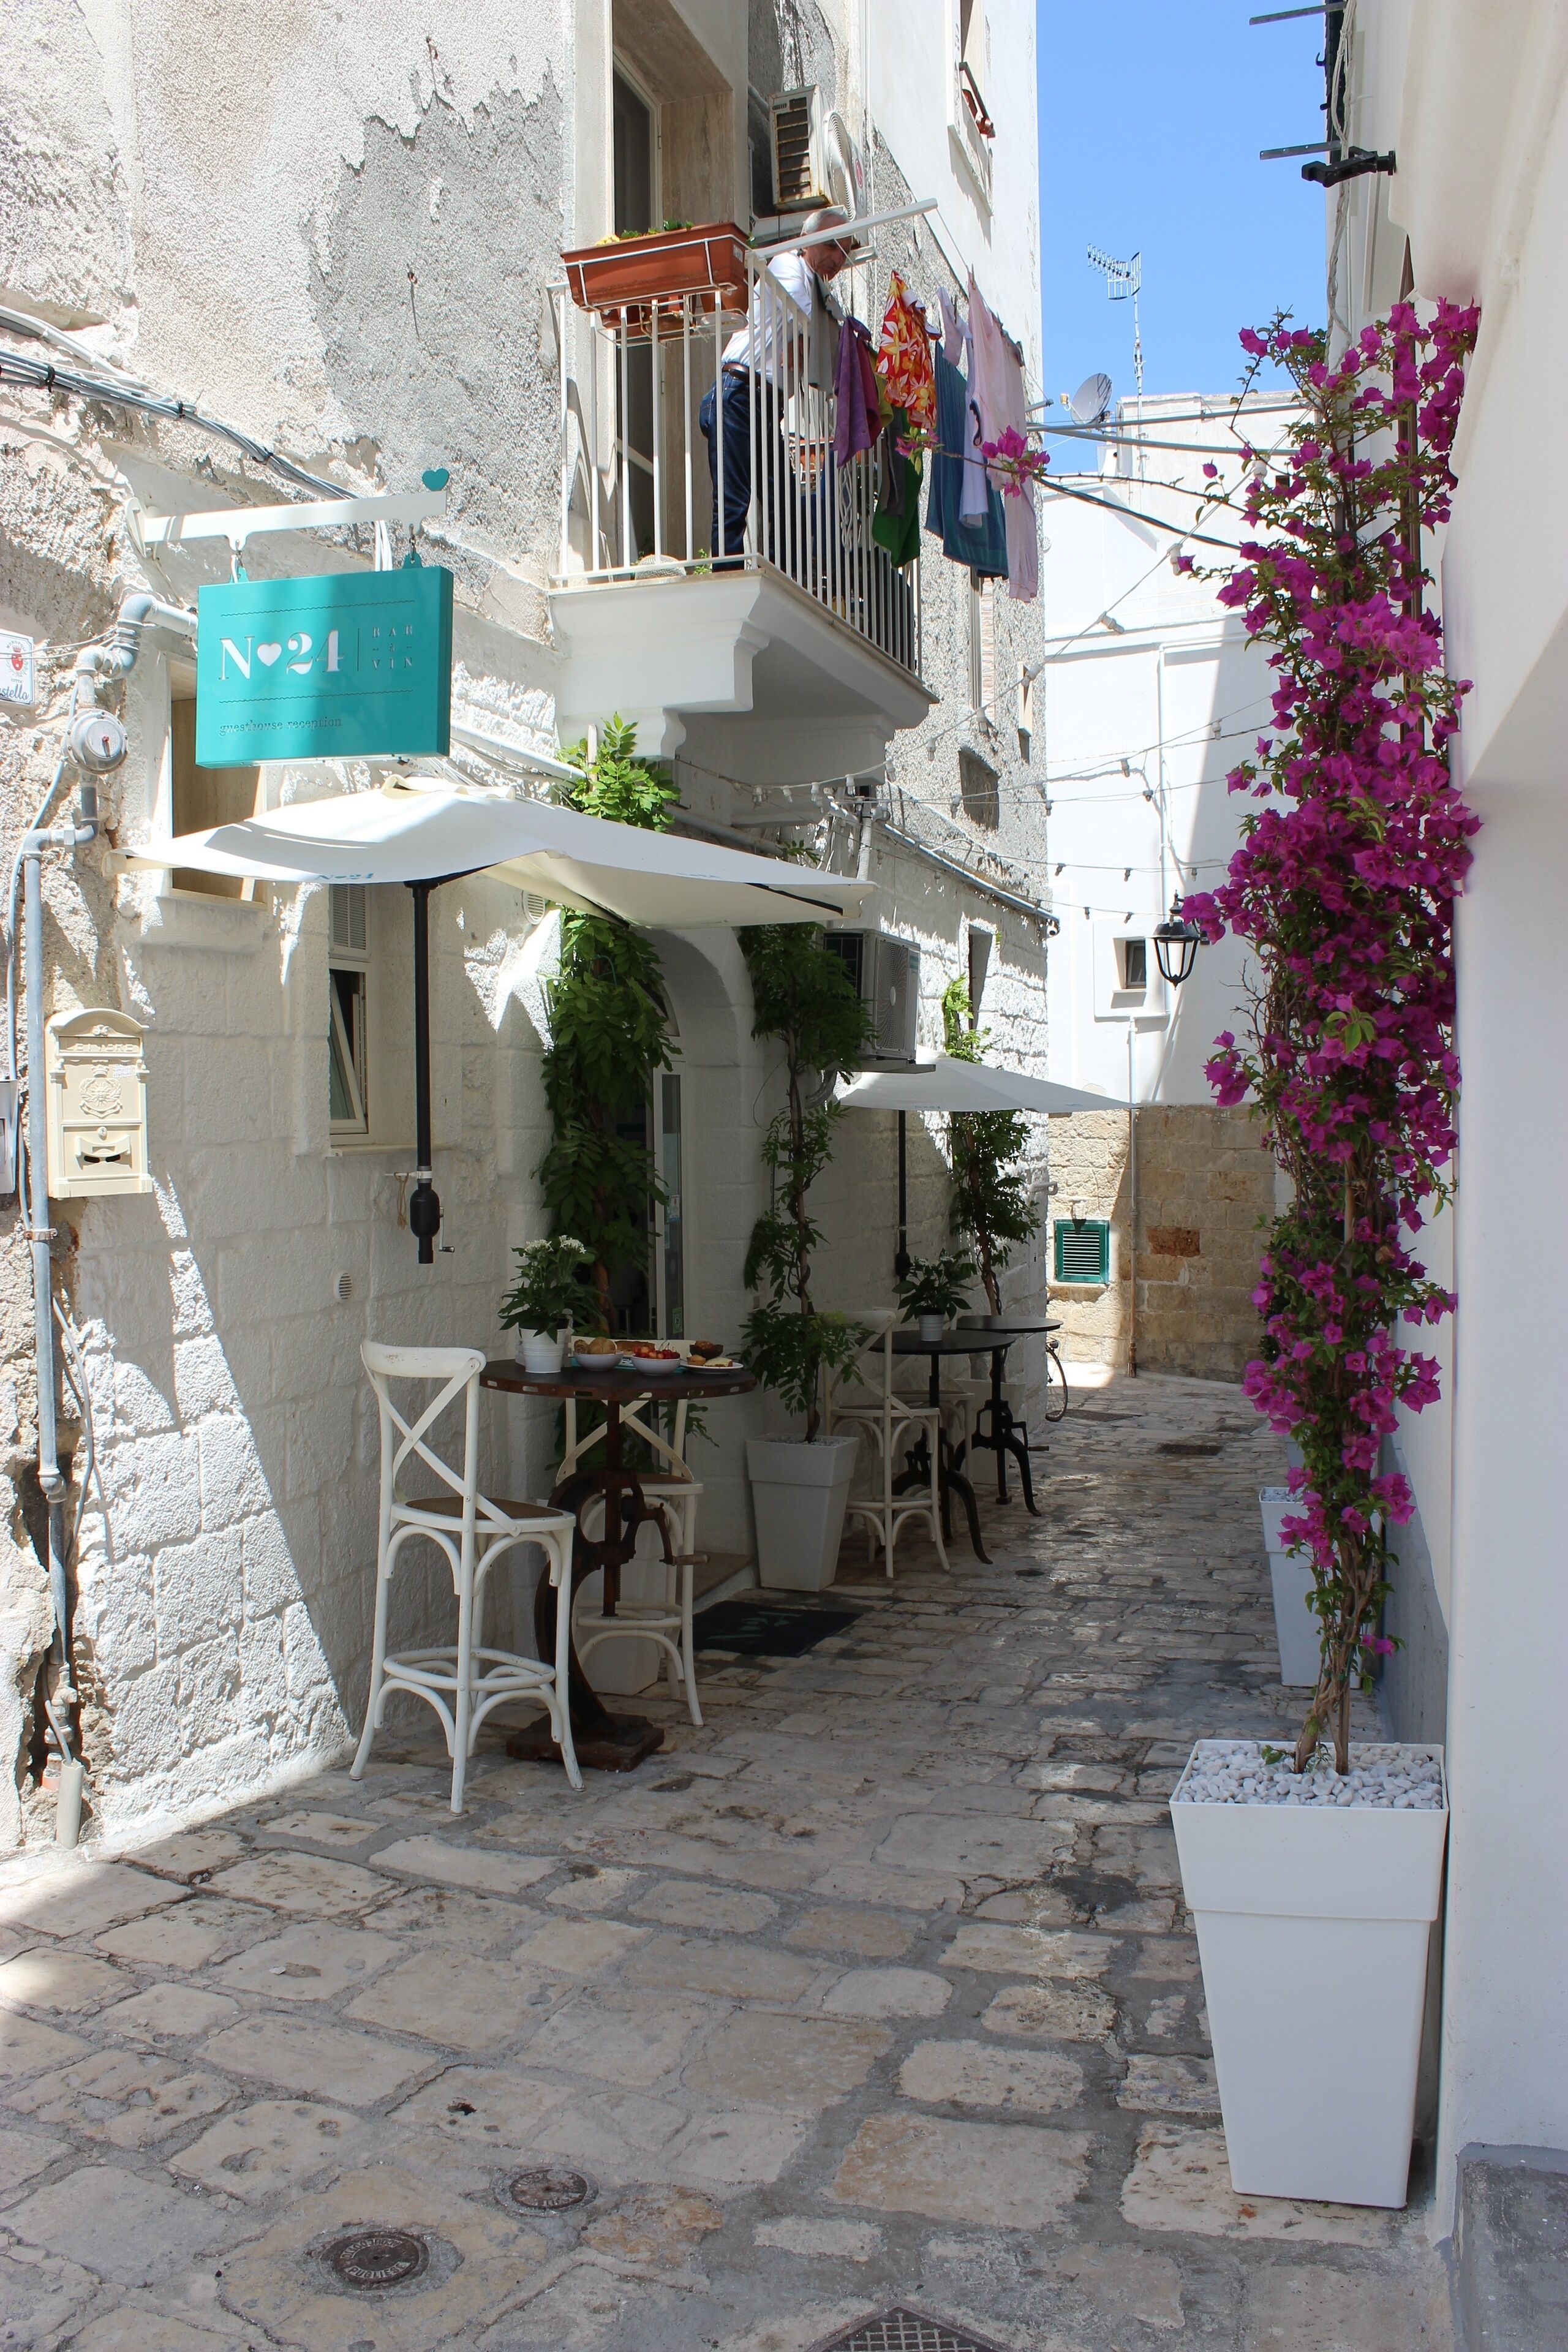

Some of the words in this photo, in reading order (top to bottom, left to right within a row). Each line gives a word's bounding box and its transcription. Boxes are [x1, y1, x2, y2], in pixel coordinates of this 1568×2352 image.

[372, 625, 412, 638] BAR
[372, 657, 413, 669] VIN
[0, 683, 29, 700] stello
[219, 720, 282, 736] guesthouse
[287, 716, 342, 731] reception
[347, 2262, 409, 2278] PUGLIESE
